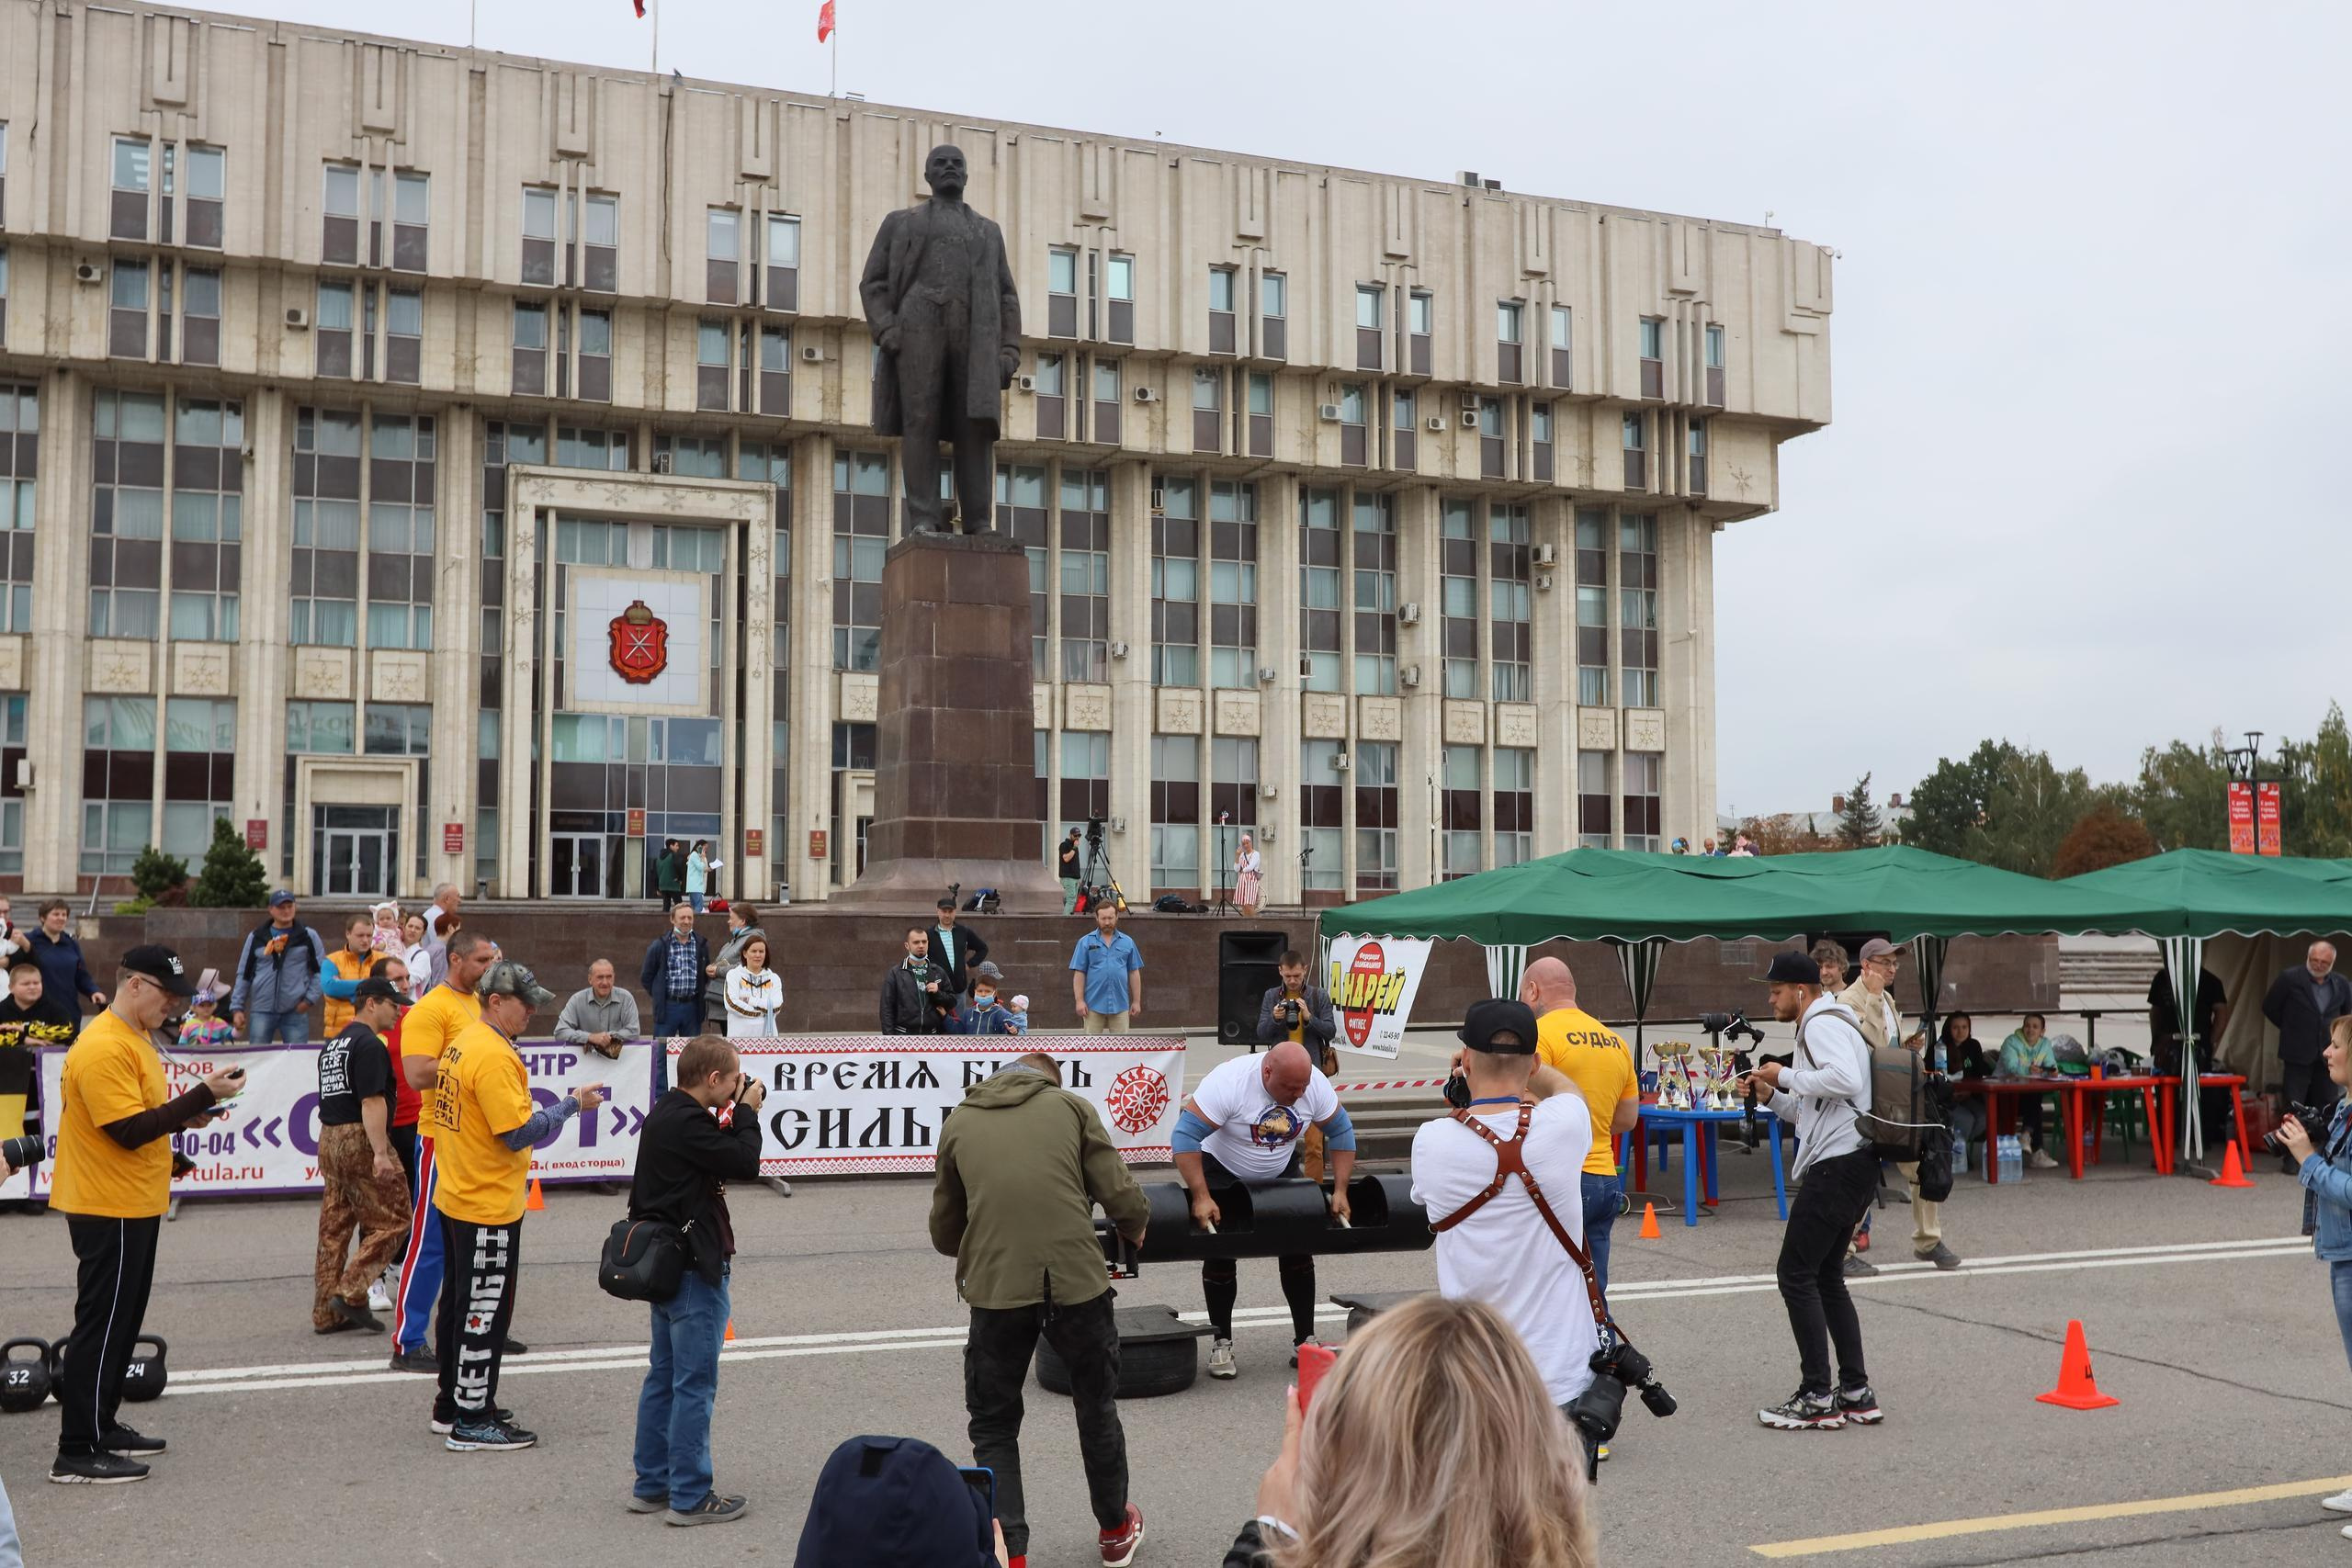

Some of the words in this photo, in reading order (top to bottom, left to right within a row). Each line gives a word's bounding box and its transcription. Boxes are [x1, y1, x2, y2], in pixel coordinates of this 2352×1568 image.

[1566, 1031, 1622, 1050] СУДЬЯ
[162, 1062, 214, 1079] тров
[520, 1053, 578, 1076] НТР
[8, 1370, 30, 1385] 32
[125, 1363, 145, 1378] 24
[453, 1344, 492, 1411] GET
